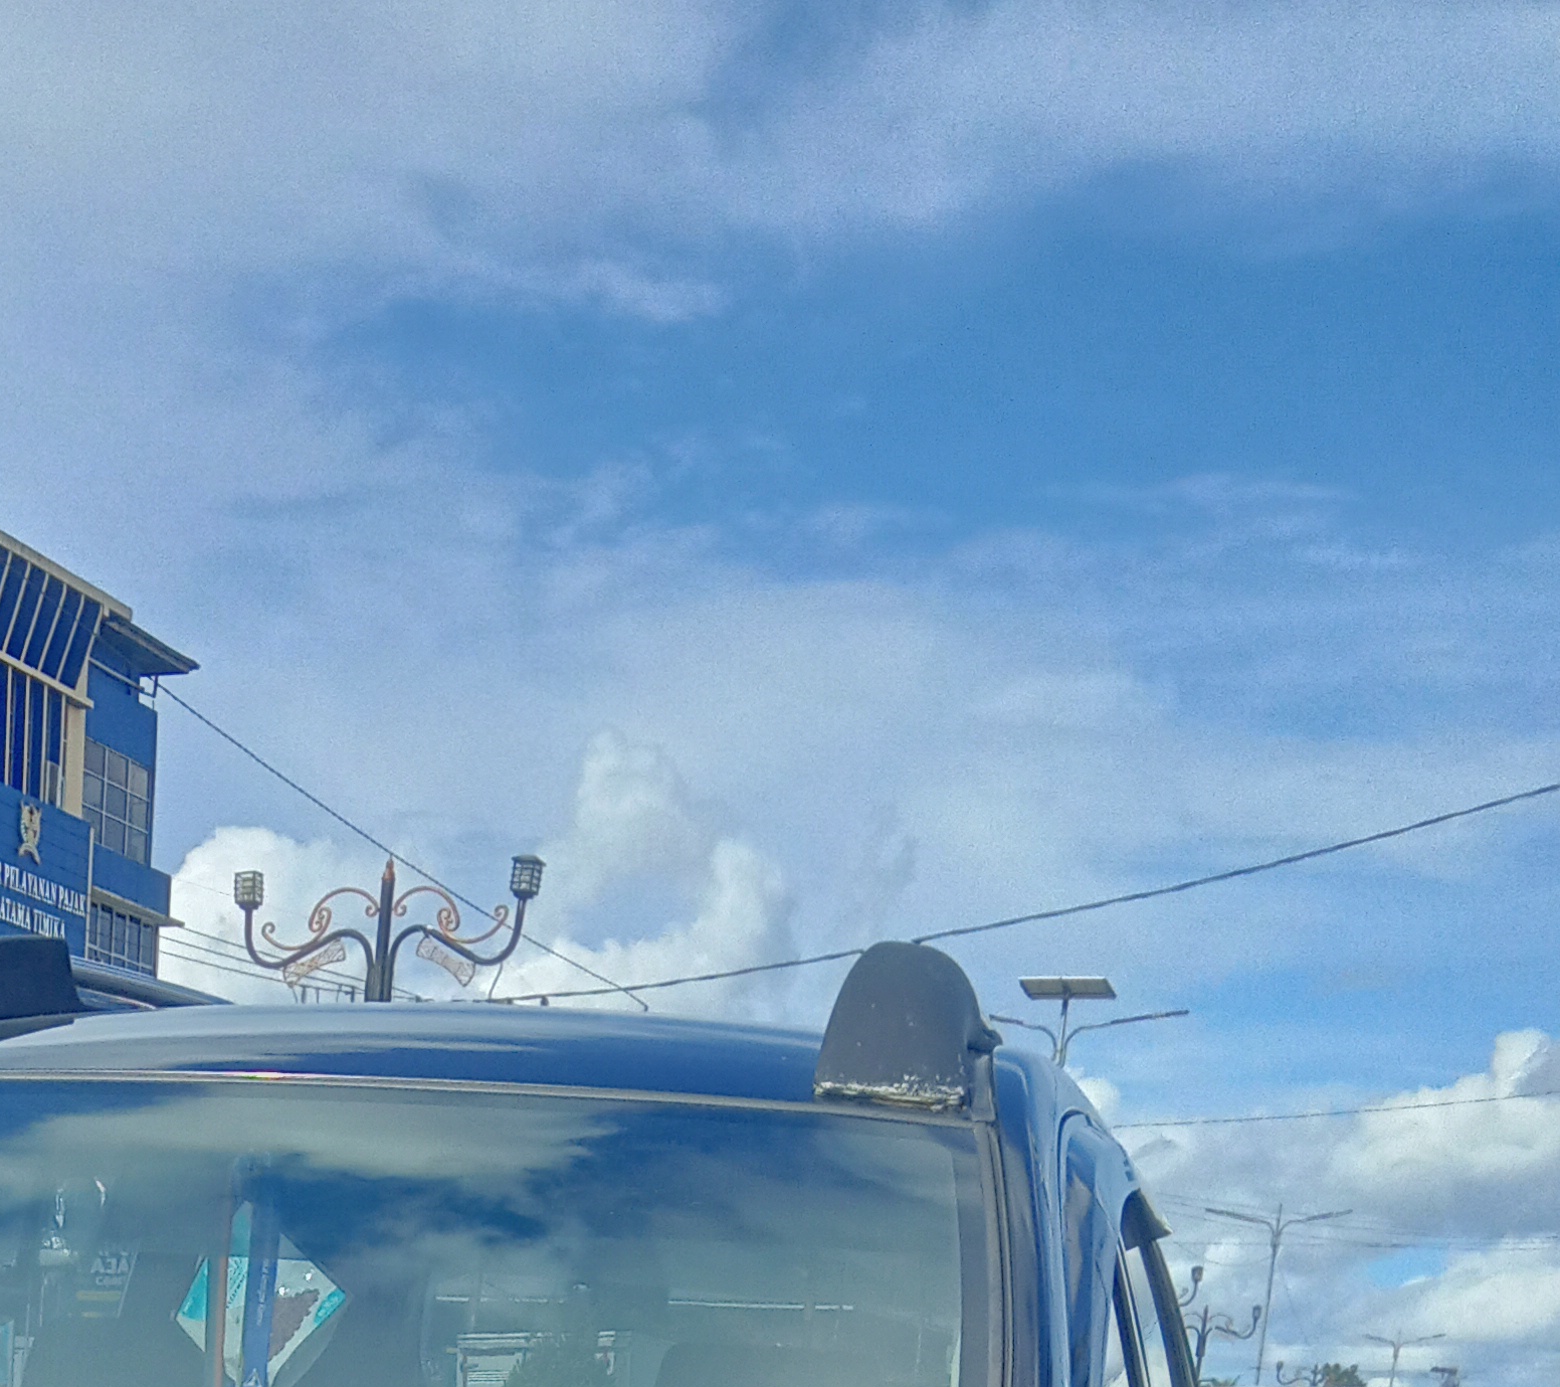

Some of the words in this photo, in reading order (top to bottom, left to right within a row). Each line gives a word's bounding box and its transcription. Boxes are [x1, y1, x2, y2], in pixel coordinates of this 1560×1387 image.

[4, 863, 57, 906] PELAYANAN
[58, 886, 87, 917] PAJAK
[33, 909, 66, 940] TIMIKA
